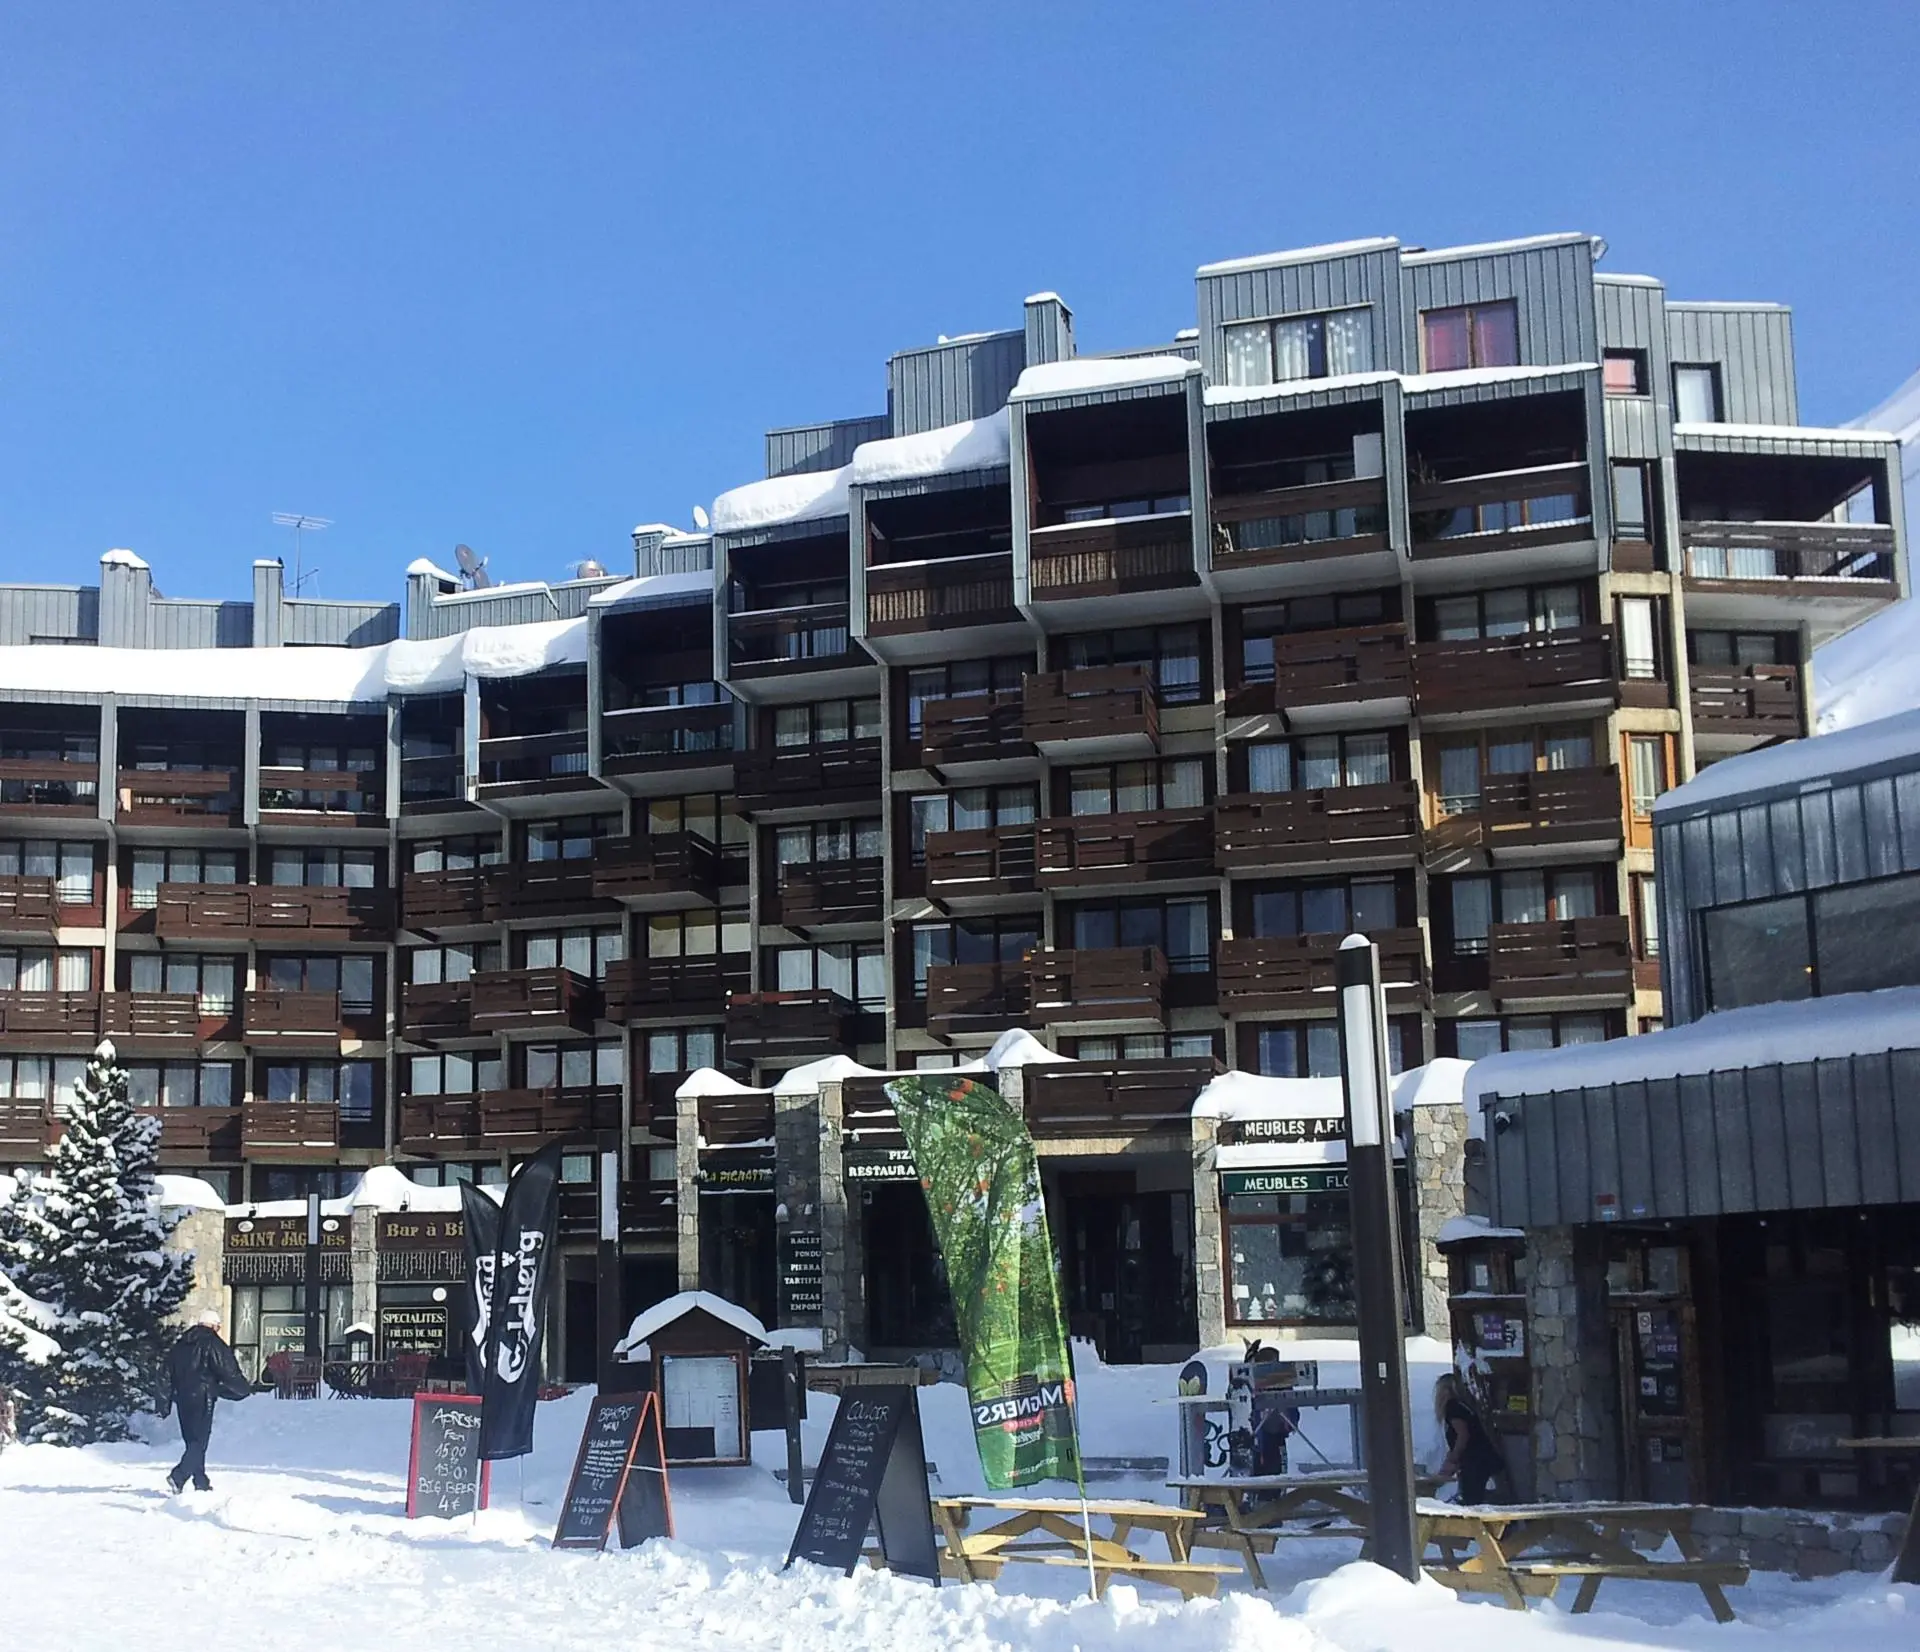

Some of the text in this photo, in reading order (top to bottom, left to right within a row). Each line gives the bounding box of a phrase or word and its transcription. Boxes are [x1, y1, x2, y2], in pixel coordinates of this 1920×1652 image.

[1245, 1121, 1305, 1136] MEUBLES
[848, 1165, 916, 1177] RESTAURA
[1244, 1176, 1308, 1191] MEUBLES
[386, 1221, 464, 1237] Bar à Bi
[230, 1232, 275, 1247] SAINT
[791, 1293, 821, 1301] PIZZAS
[497, 1230, 544, 1384] Clsberg
[383, 1312, 446, 1324] SPECIALITES:
